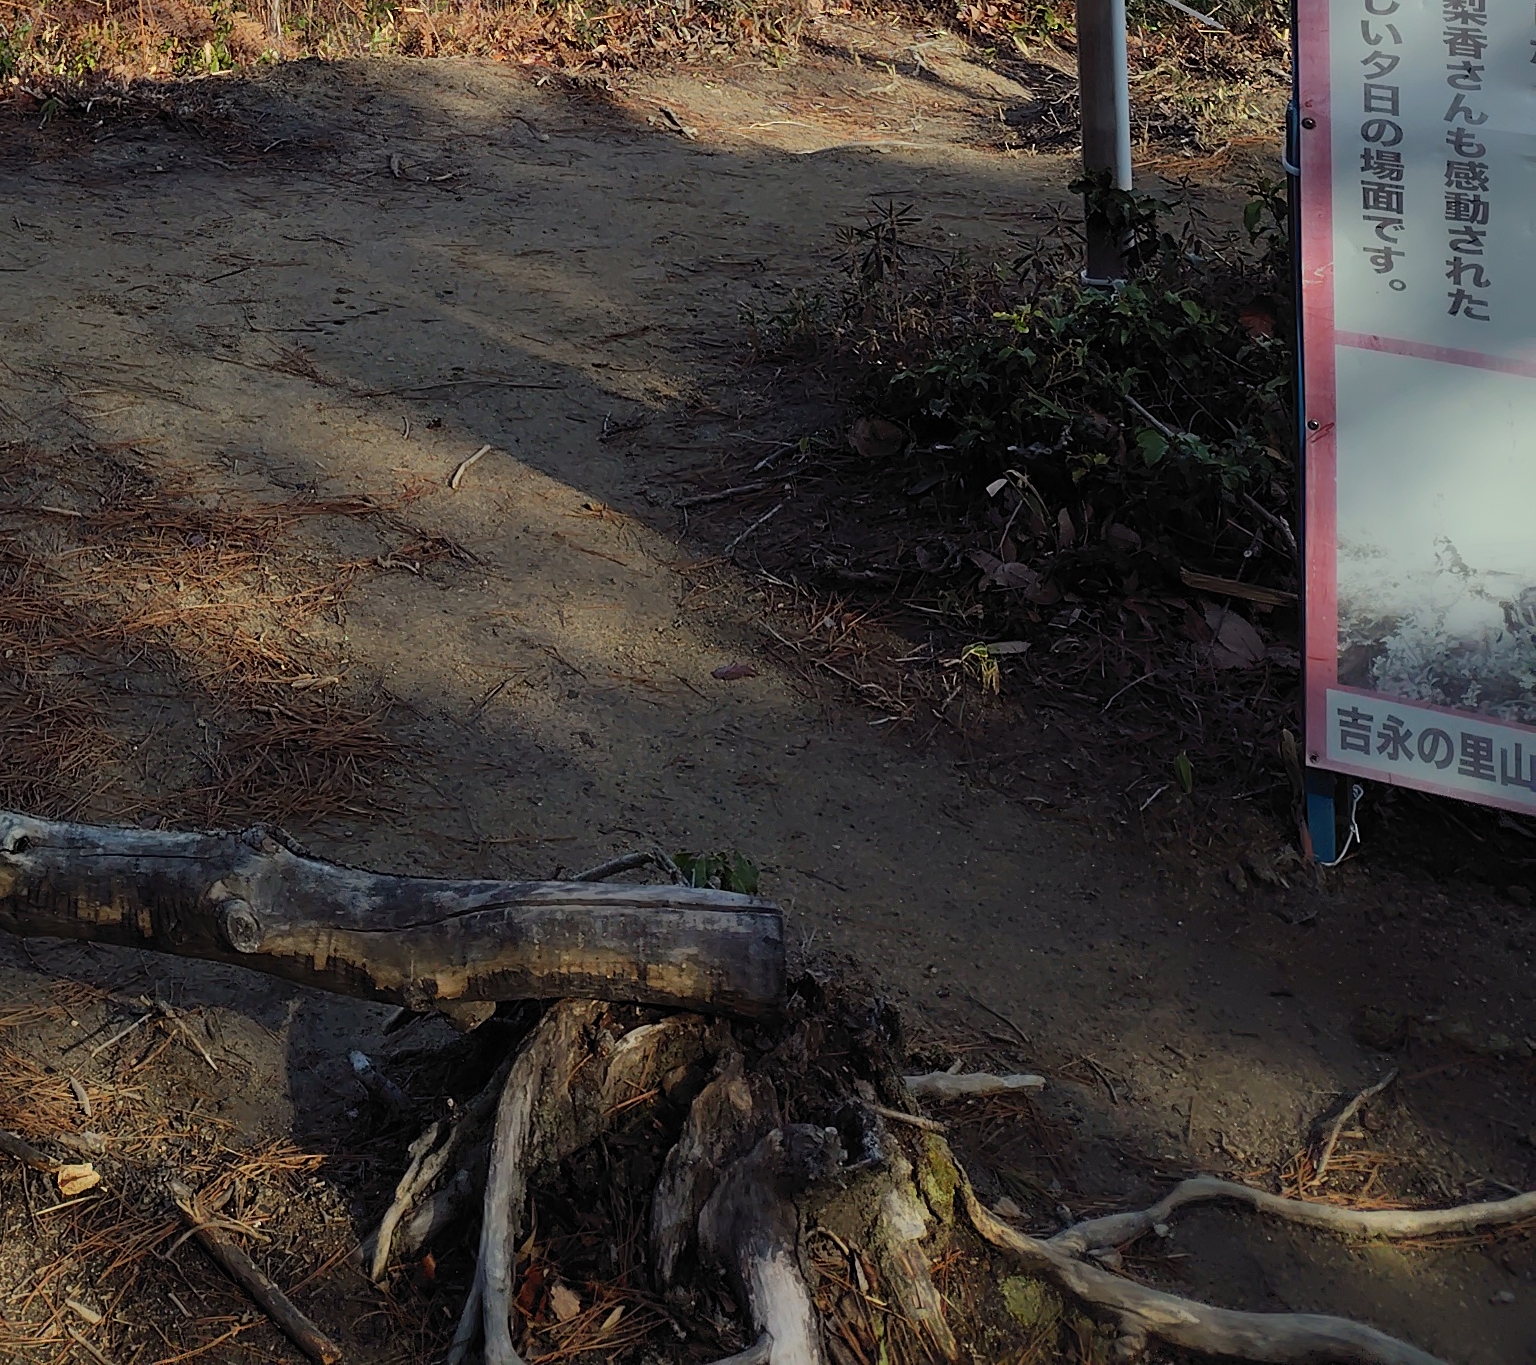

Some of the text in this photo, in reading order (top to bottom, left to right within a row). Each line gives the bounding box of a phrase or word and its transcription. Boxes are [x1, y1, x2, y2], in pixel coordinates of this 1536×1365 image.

[1337, 706, 1536, 792] 吉永の里山
